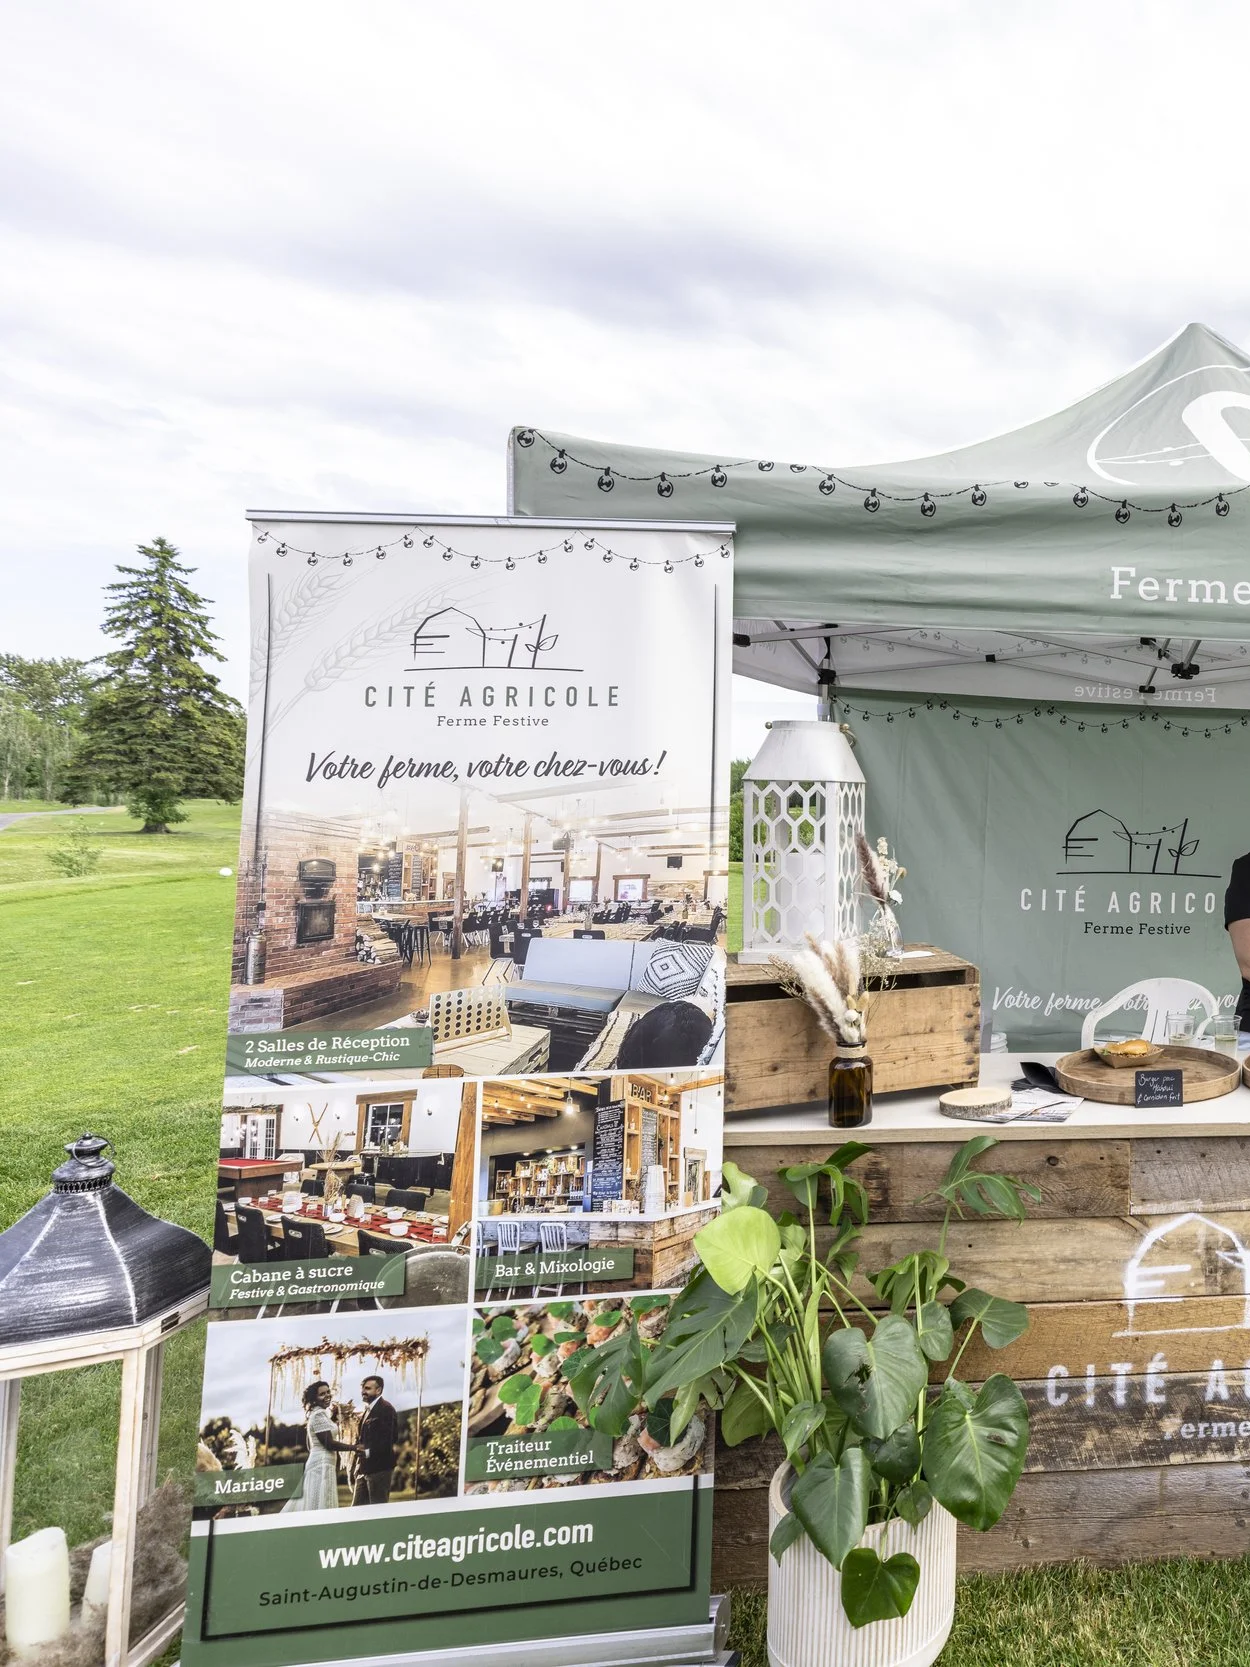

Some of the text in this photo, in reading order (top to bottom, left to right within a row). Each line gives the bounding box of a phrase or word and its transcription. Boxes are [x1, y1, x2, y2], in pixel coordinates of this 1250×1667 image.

[365, 681, 620, 708] CITÉ AGRICOLE
[436, 715, 550, 727] Ferme Festive
[305, 750, 376, 783] Votre
[376, 755, 460, 789] ferme,
[467, 753, 531, 779] votre
[1020, 884, 1086, 912] CITÉ
[1083, 921, 1191, 935] Ferme Festive
[991, 986, 1043, 1011] Votre
[245, 1035, 411, 1054] 2 Salles de Réception
[244, 1051, 401, 1068] Moderne & Rustique-Chic
[230, 1265, 354, 1284] Cabane à sucre
[494, 1257, 615, 1278] Bar & Mixologie
[229, 1279, 385, 1300] Festive & Gastronomique
[1046, 1352, 1169, 1408] CITÉ
[485, 1438, 553, 1456] Traiteur
[485, 1449, 595, 1473] Événementiel
[213, 1475, 285, 1495] Mariage
[318, 1522, 594, 1570] www.citeagricole.com
[258, 1555, 643, 1607] Saint-Augustin-de-Desmaures, Québec
